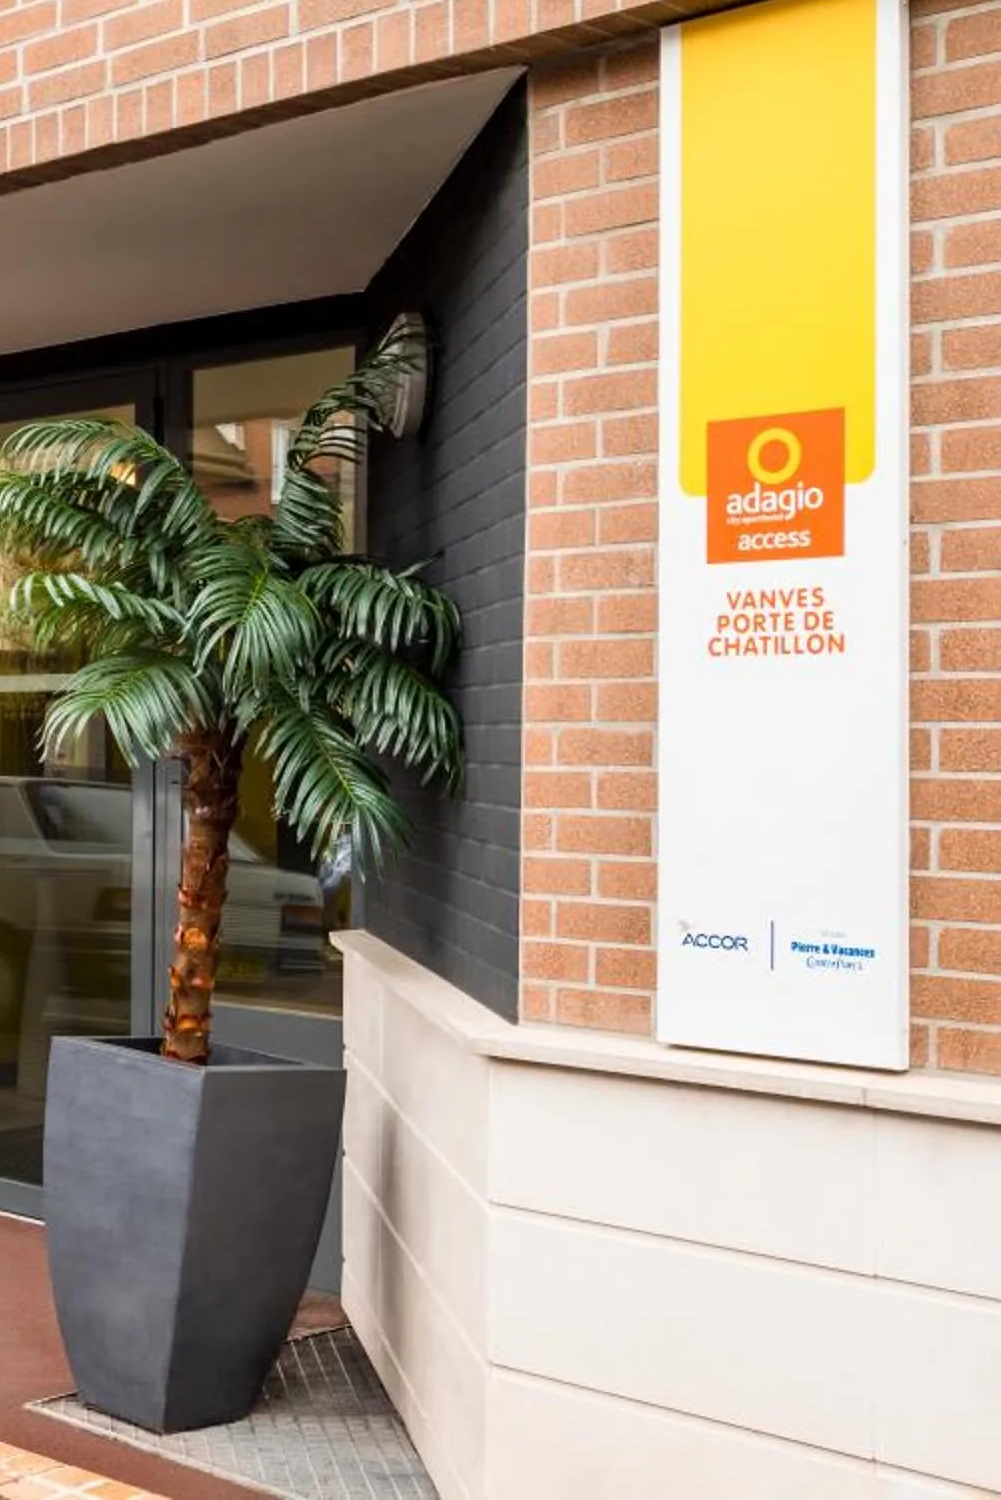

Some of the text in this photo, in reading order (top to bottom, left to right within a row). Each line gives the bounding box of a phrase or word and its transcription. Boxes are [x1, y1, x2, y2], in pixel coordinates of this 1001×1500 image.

[726, 481, 824, 520] adagio
[737, 530, 811, 552] access
[726, 587, 825, 611] VANVES
[717, 611, 835, 634] PORTE DE
[707, 633, 846, 657] CHATILLON
[682, 933, 749, 951] ACCOR
[791, 941, 820, 954] Pierre
